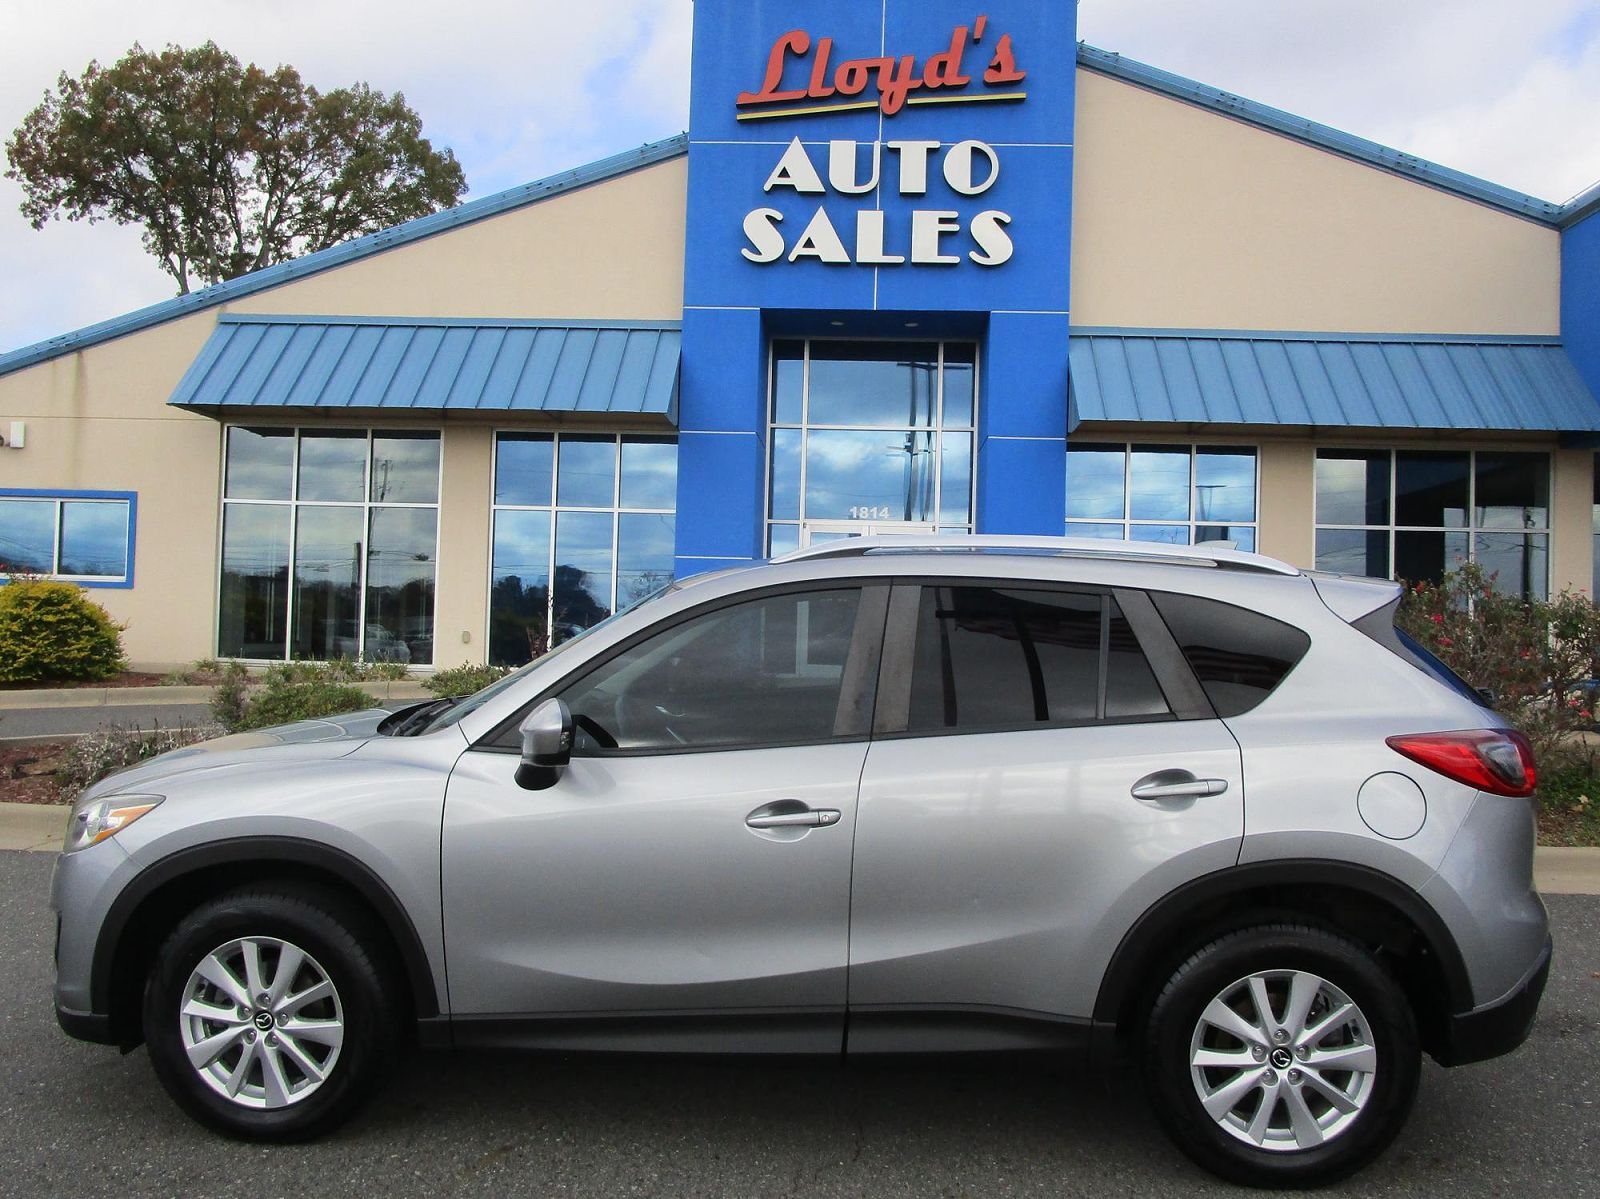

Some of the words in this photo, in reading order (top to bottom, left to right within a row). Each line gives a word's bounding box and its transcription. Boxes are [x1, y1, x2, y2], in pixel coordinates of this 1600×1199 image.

[736, 15, 1026, 115] Lloyd's
[763, 135, 999, 195] AUTO
[741, 205, 1013, 266] SALES
[850, 506, 890, 519] 1814
